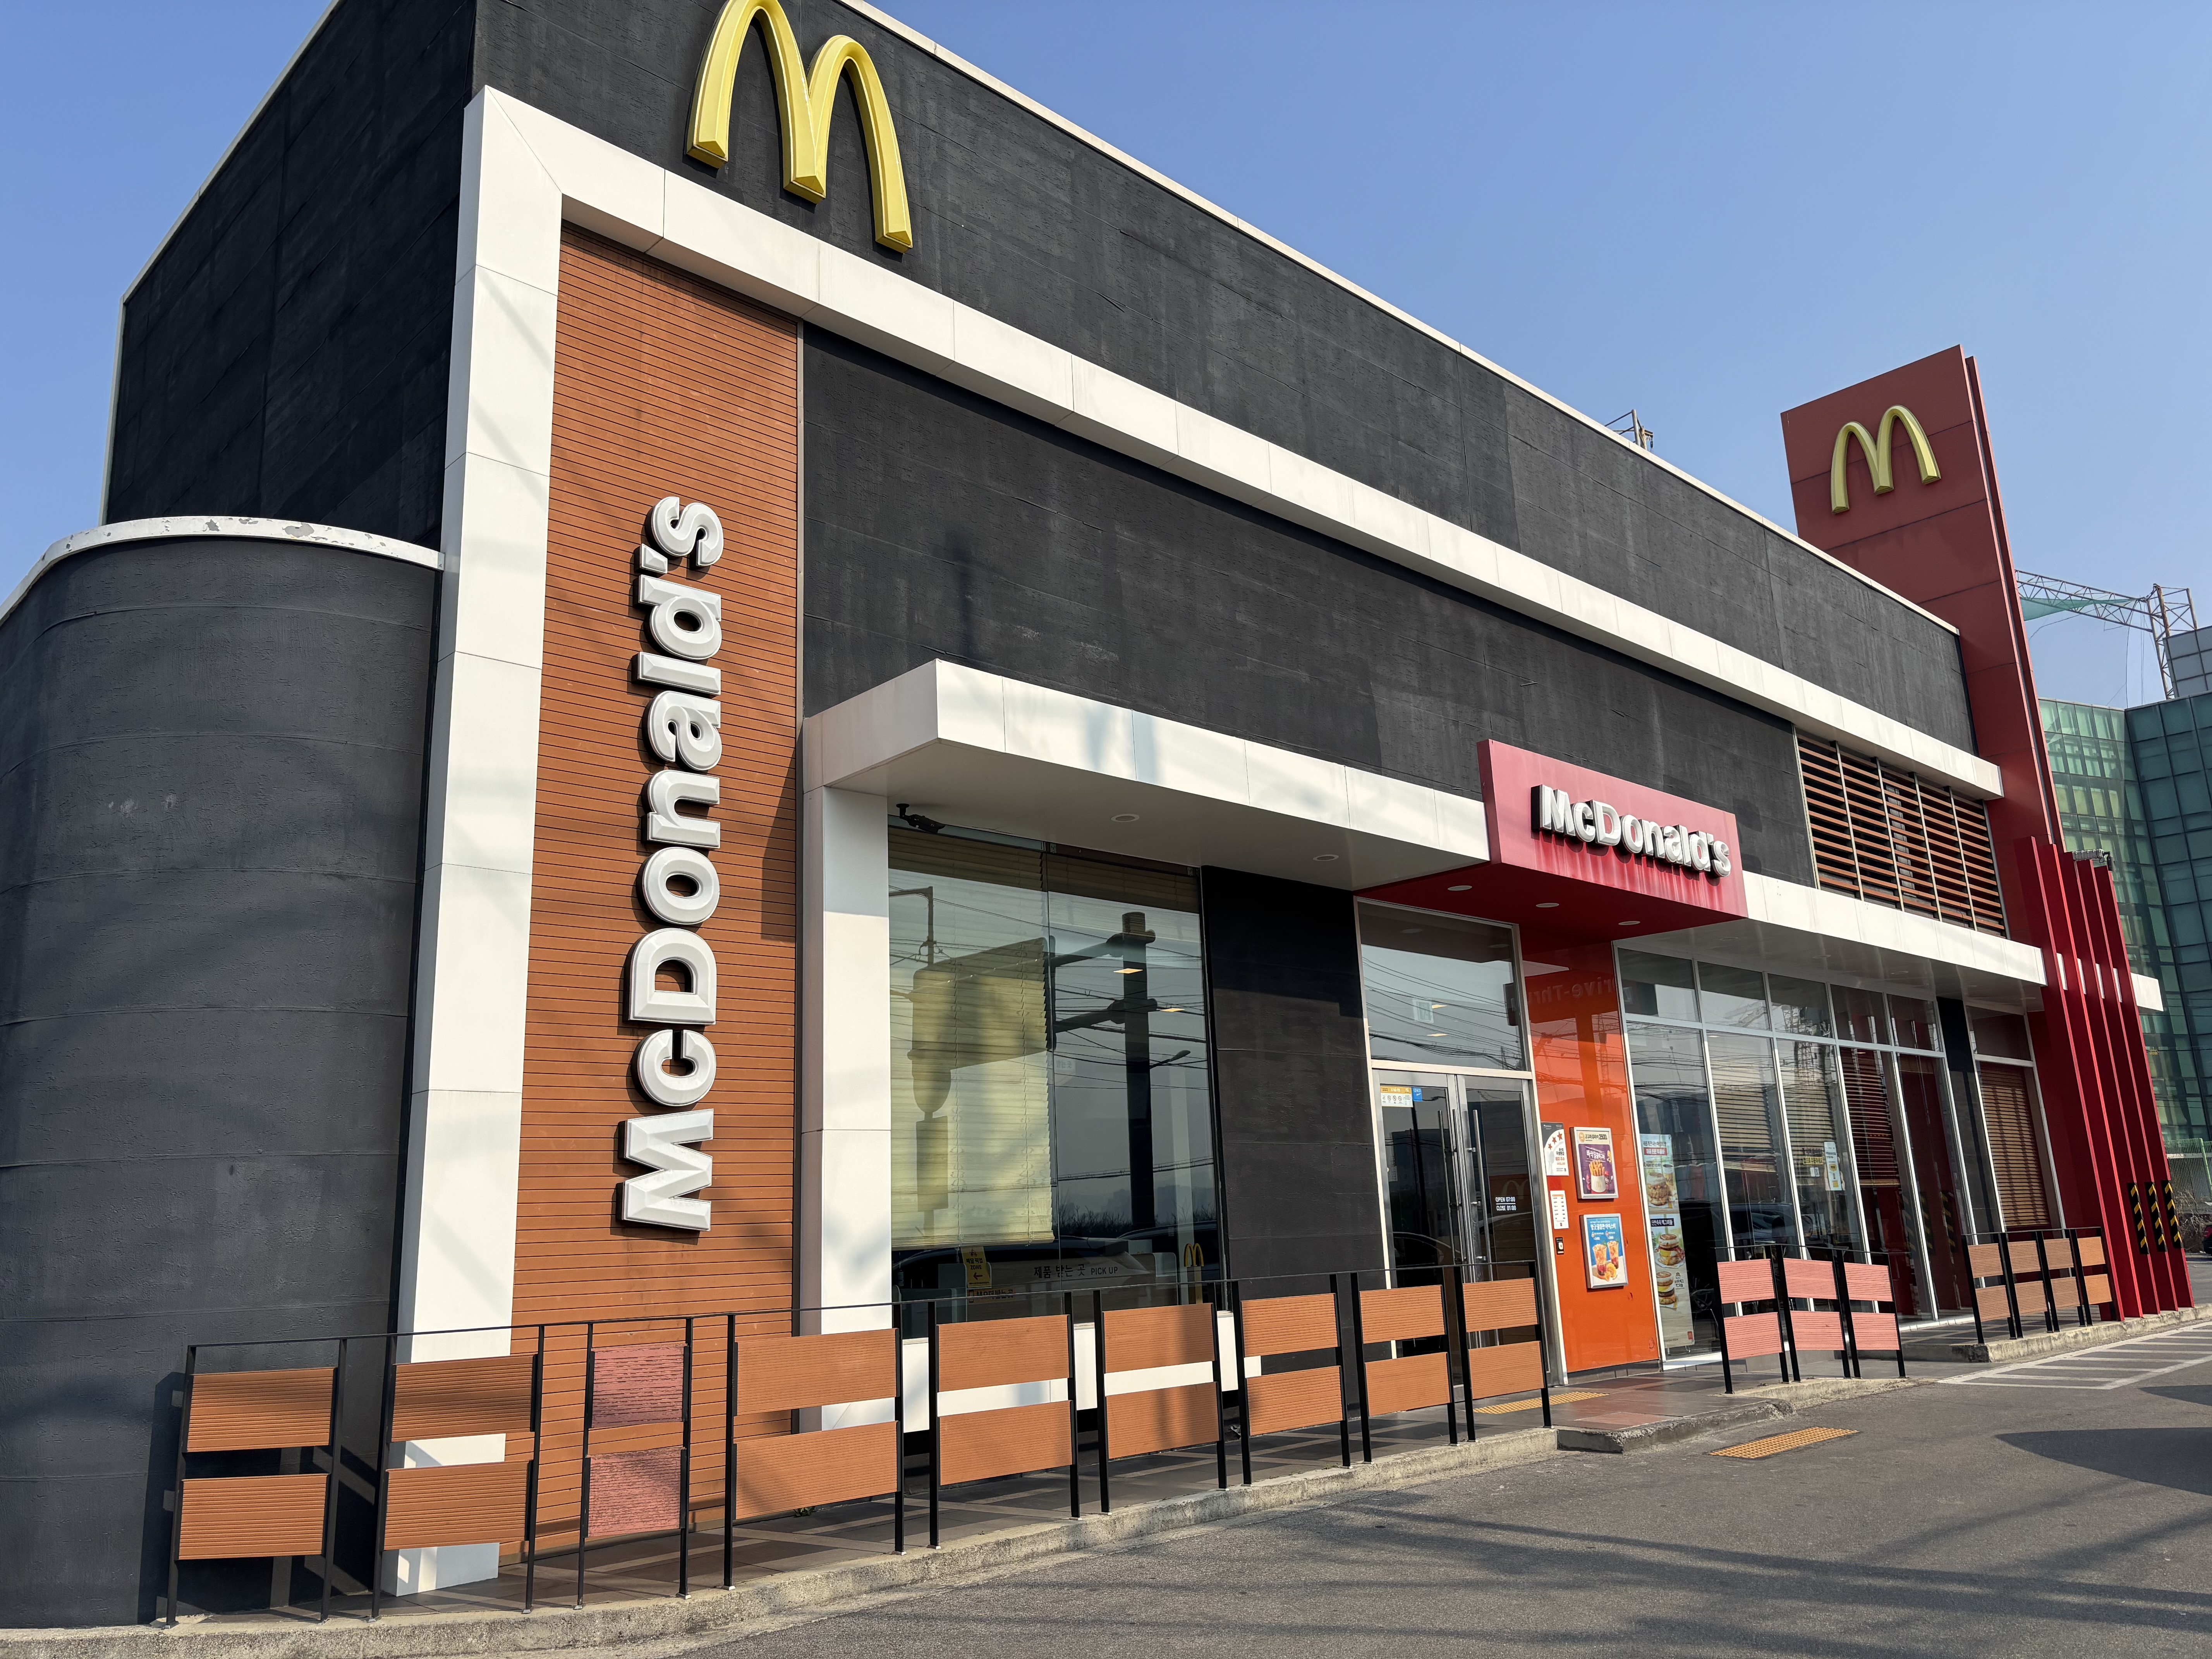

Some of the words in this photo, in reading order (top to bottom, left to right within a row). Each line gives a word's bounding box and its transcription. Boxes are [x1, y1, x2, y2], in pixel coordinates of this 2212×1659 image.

[622, 496, 725, 1231] McDonald's
[1537, 784, 1731, 877] McDonald's
[1034, 1266, 1051, 1278] 제품
[1056, 1265, 1073, 1278] 받는
[1078, 1264, 1085, 1276] 곳
[1091, 1267, 1106, 1275] PICK
